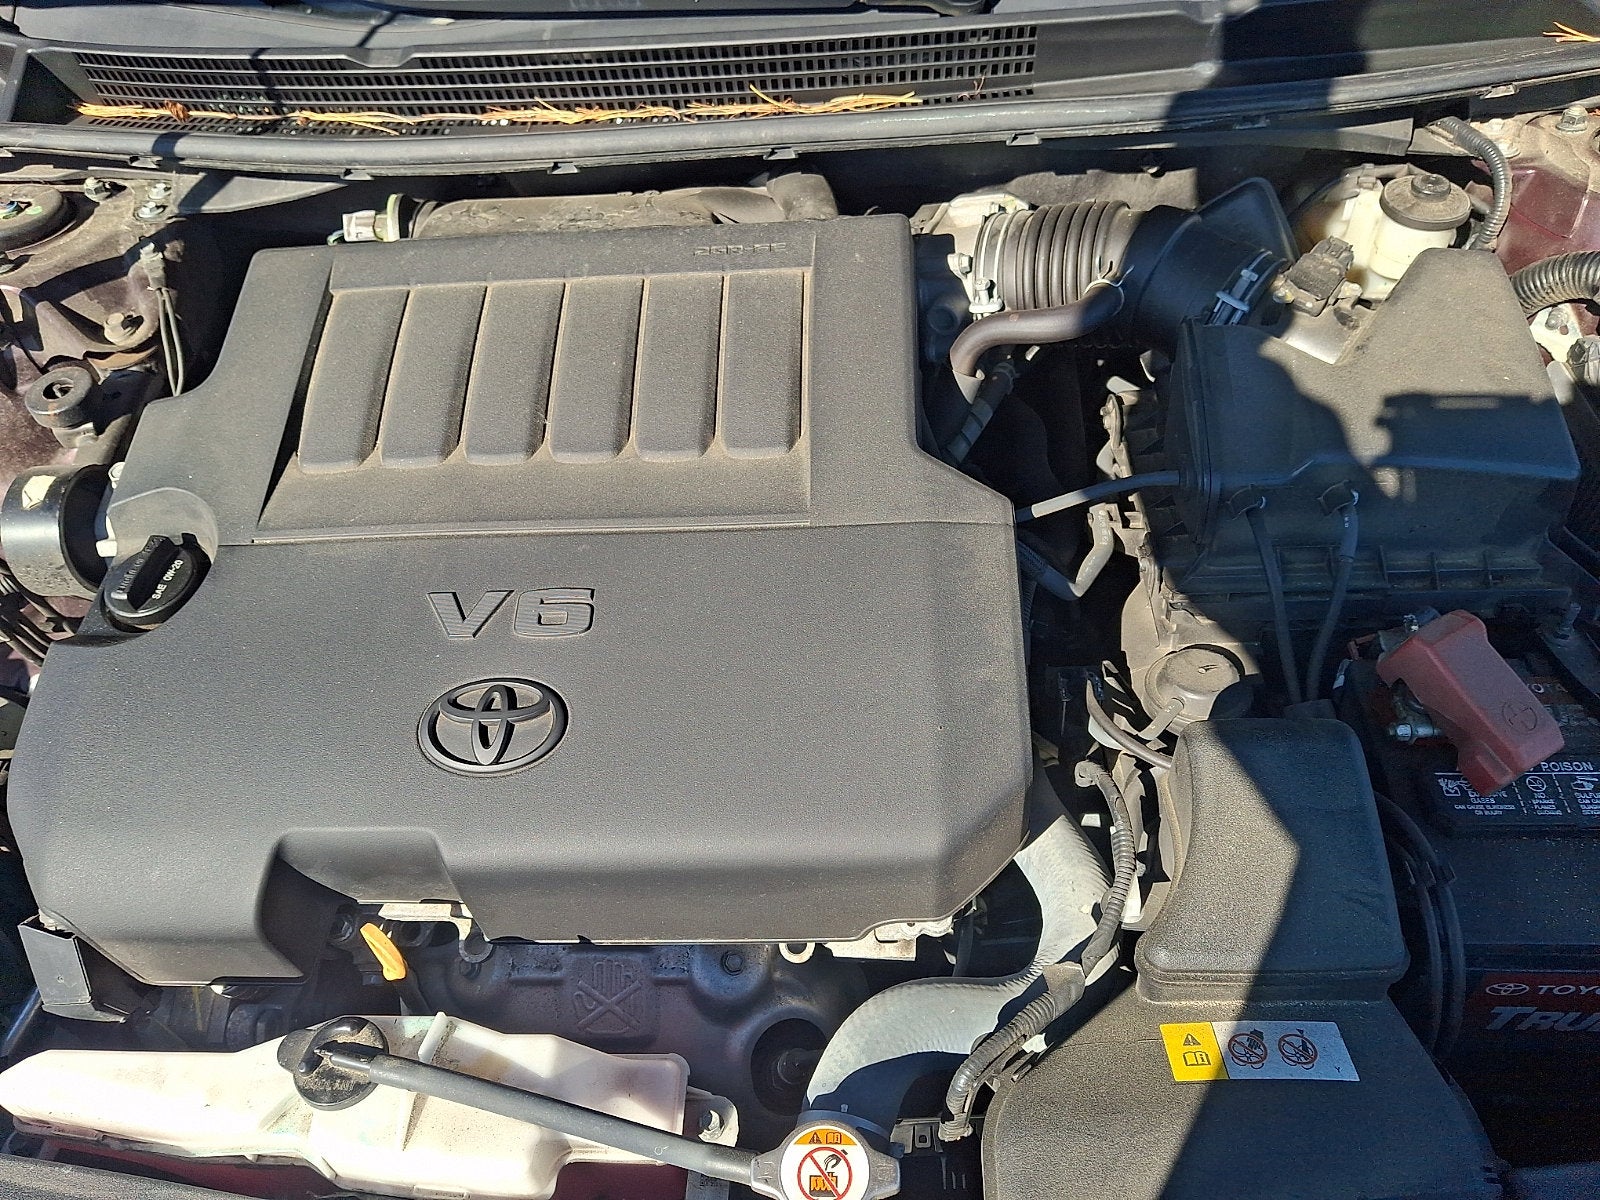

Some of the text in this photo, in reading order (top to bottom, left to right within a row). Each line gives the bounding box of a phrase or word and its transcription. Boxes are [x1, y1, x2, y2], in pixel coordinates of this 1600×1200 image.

[151, 559, 184, 600] SAE 0W-20
[427, 587, 596, 640] V6
[1540, 761, 1594, 772] POISON
[1538, 985, 1600, 995] TOY
